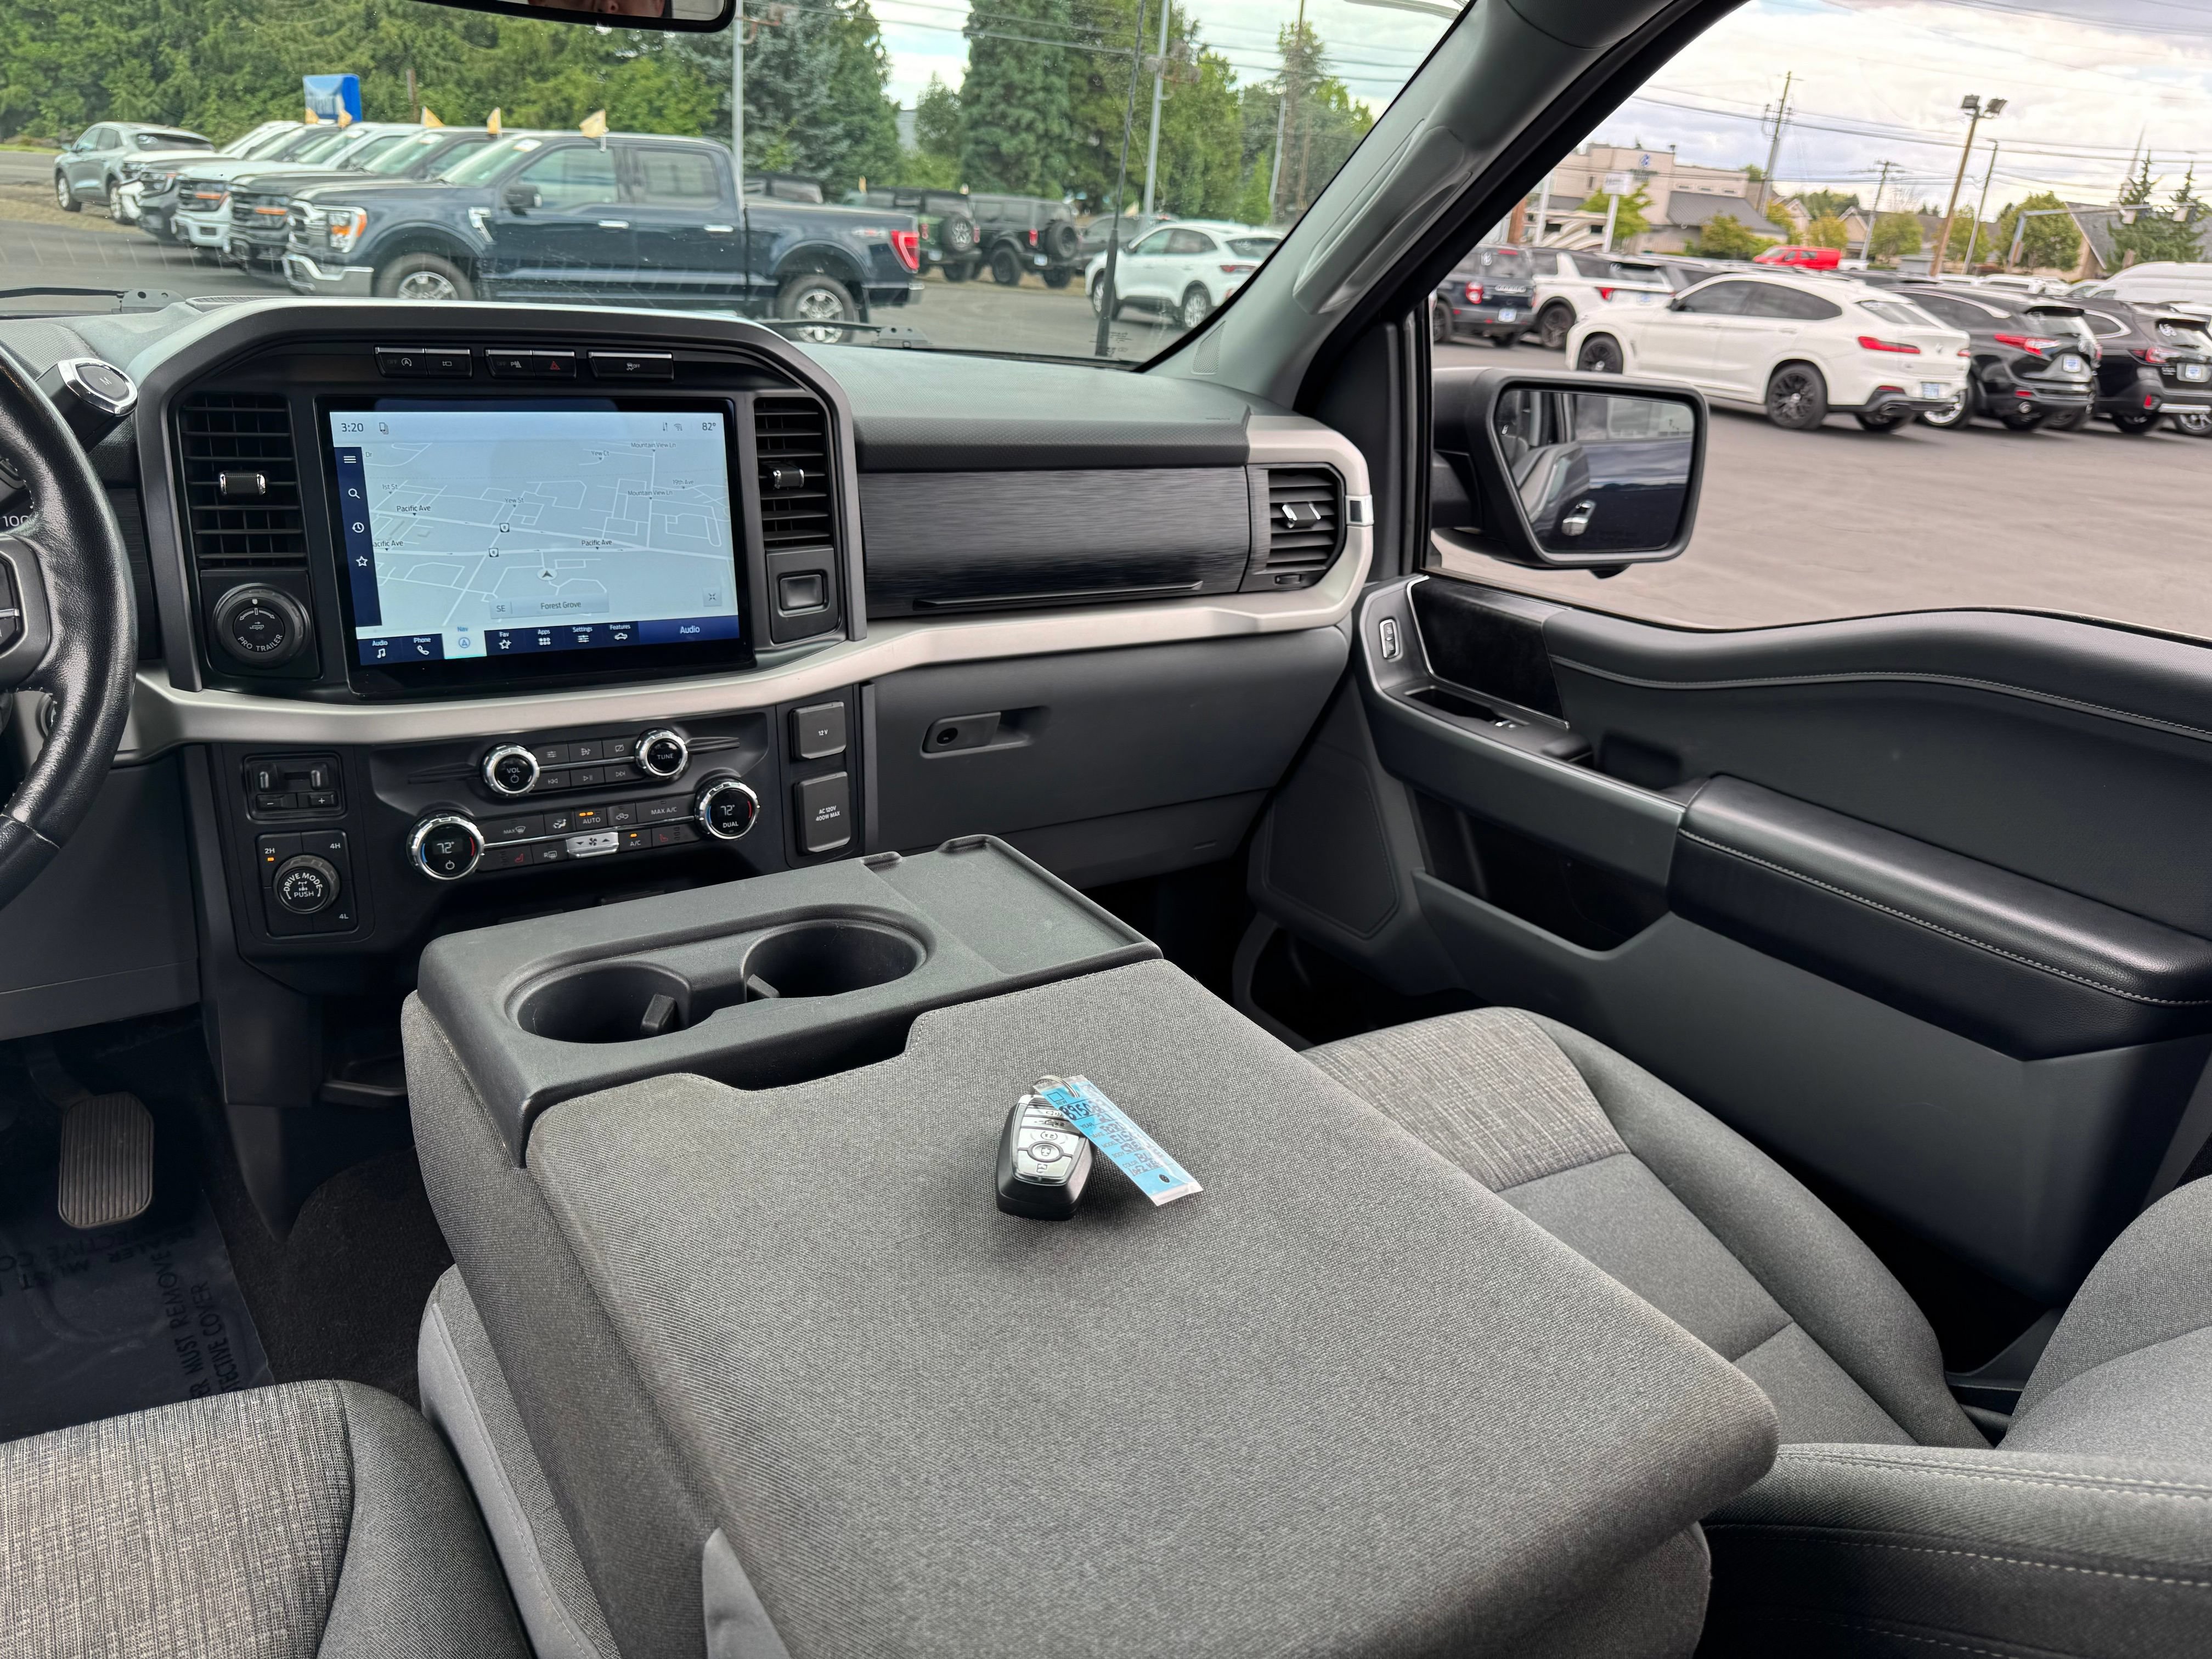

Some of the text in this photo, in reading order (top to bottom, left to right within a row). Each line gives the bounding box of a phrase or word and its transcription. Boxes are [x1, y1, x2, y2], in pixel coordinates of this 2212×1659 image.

[341, 423, 364, 432] 3:20
[702, 422, 716, 431] 82°
[238, 634, 283, 652] PRO TRAILER
[283, 872, 324, 891] DRIVE MODE
[150, 1250, 190, 1330] REMOVE
[190, 1280, 226, 1337] COVER
[174, 1333, 204, 1375] MUST
